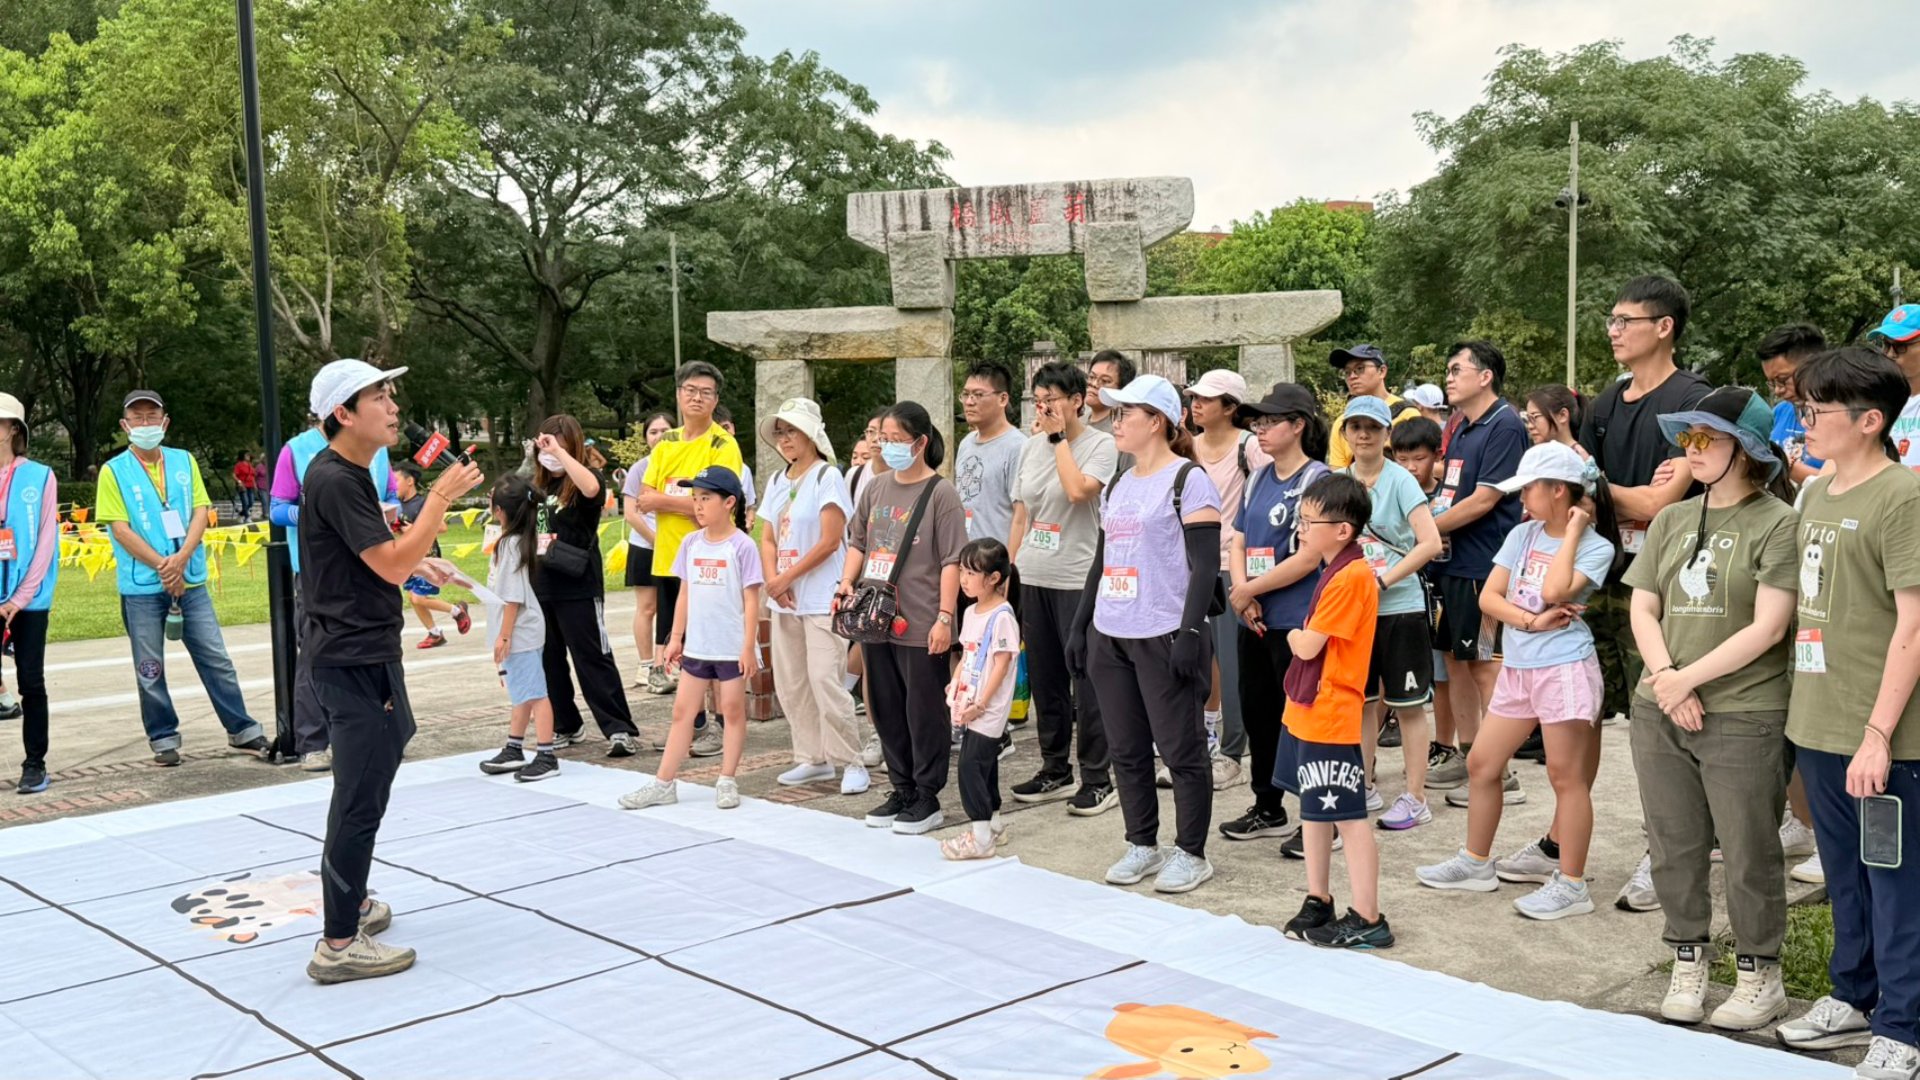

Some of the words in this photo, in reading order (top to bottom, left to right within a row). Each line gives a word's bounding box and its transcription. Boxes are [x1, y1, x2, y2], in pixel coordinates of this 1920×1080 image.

[1033, 530, 1051, 544] 205
[1803, 522, 1836, 544] Tyto
[1683, 533, 1733, 549] Tto
[871, 561, 889, 575] 510
[1249, 557, 1266, 570] 204
[1527, 561, 1549, 578] 51
[699, 567, 718, 579] 308
[1109, 577, 1129, 592] 306
[1404, 670, 1419, 691] A
[1297, 760, 1365, 793] CONVERSE
